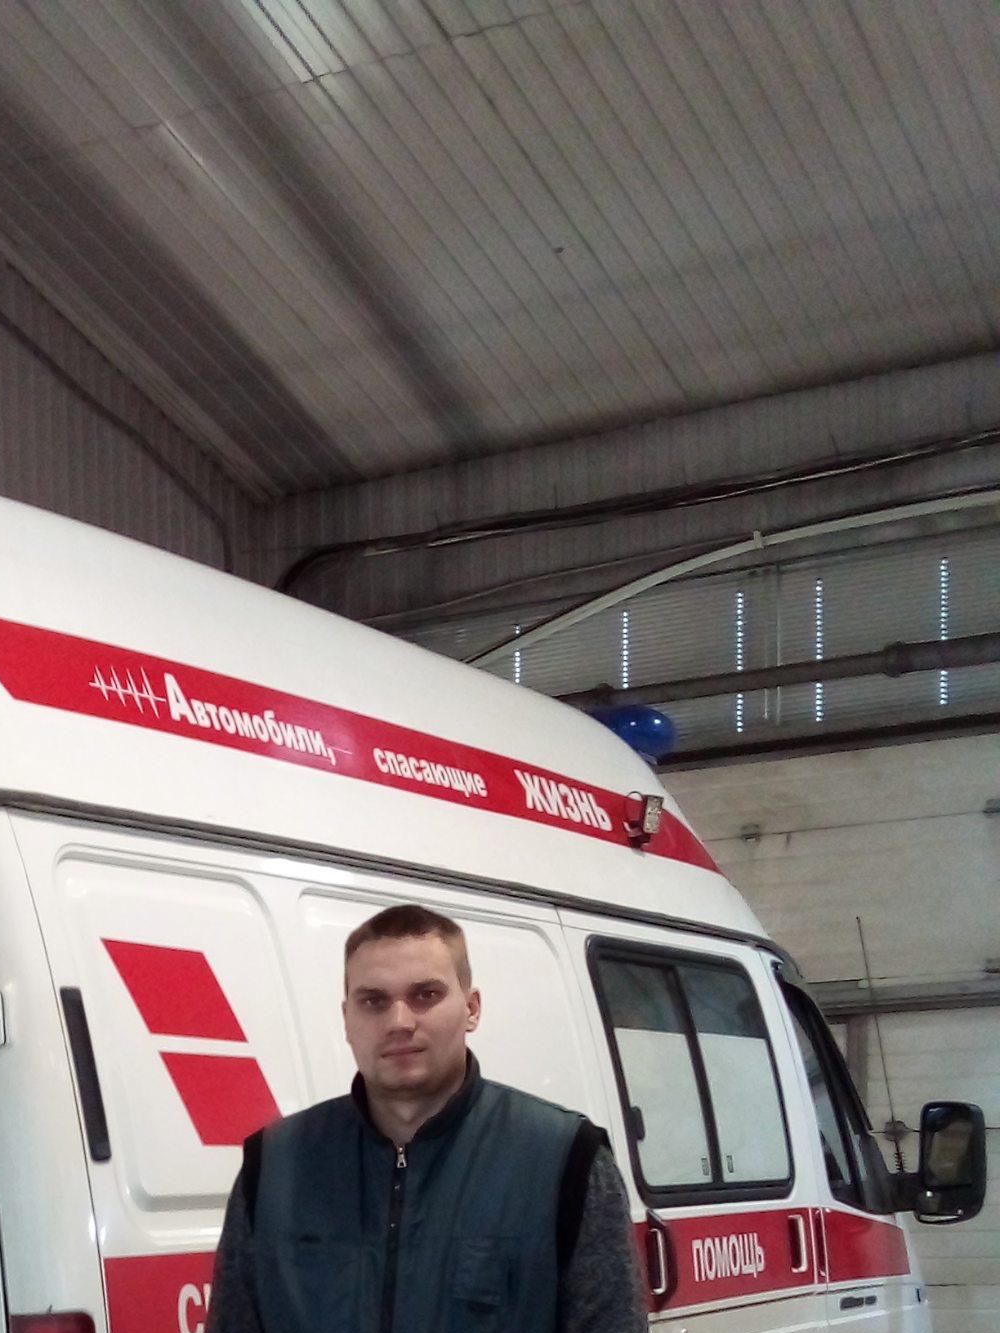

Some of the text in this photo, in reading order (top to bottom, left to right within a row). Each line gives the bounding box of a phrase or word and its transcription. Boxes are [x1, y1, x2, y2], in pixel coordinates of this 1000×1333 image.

[163, 672, 336, 766] Автомобили,
[373, 747, 488, 798] спасающие
[692, 1232, 765, 1282] ПОМОЩЬ
